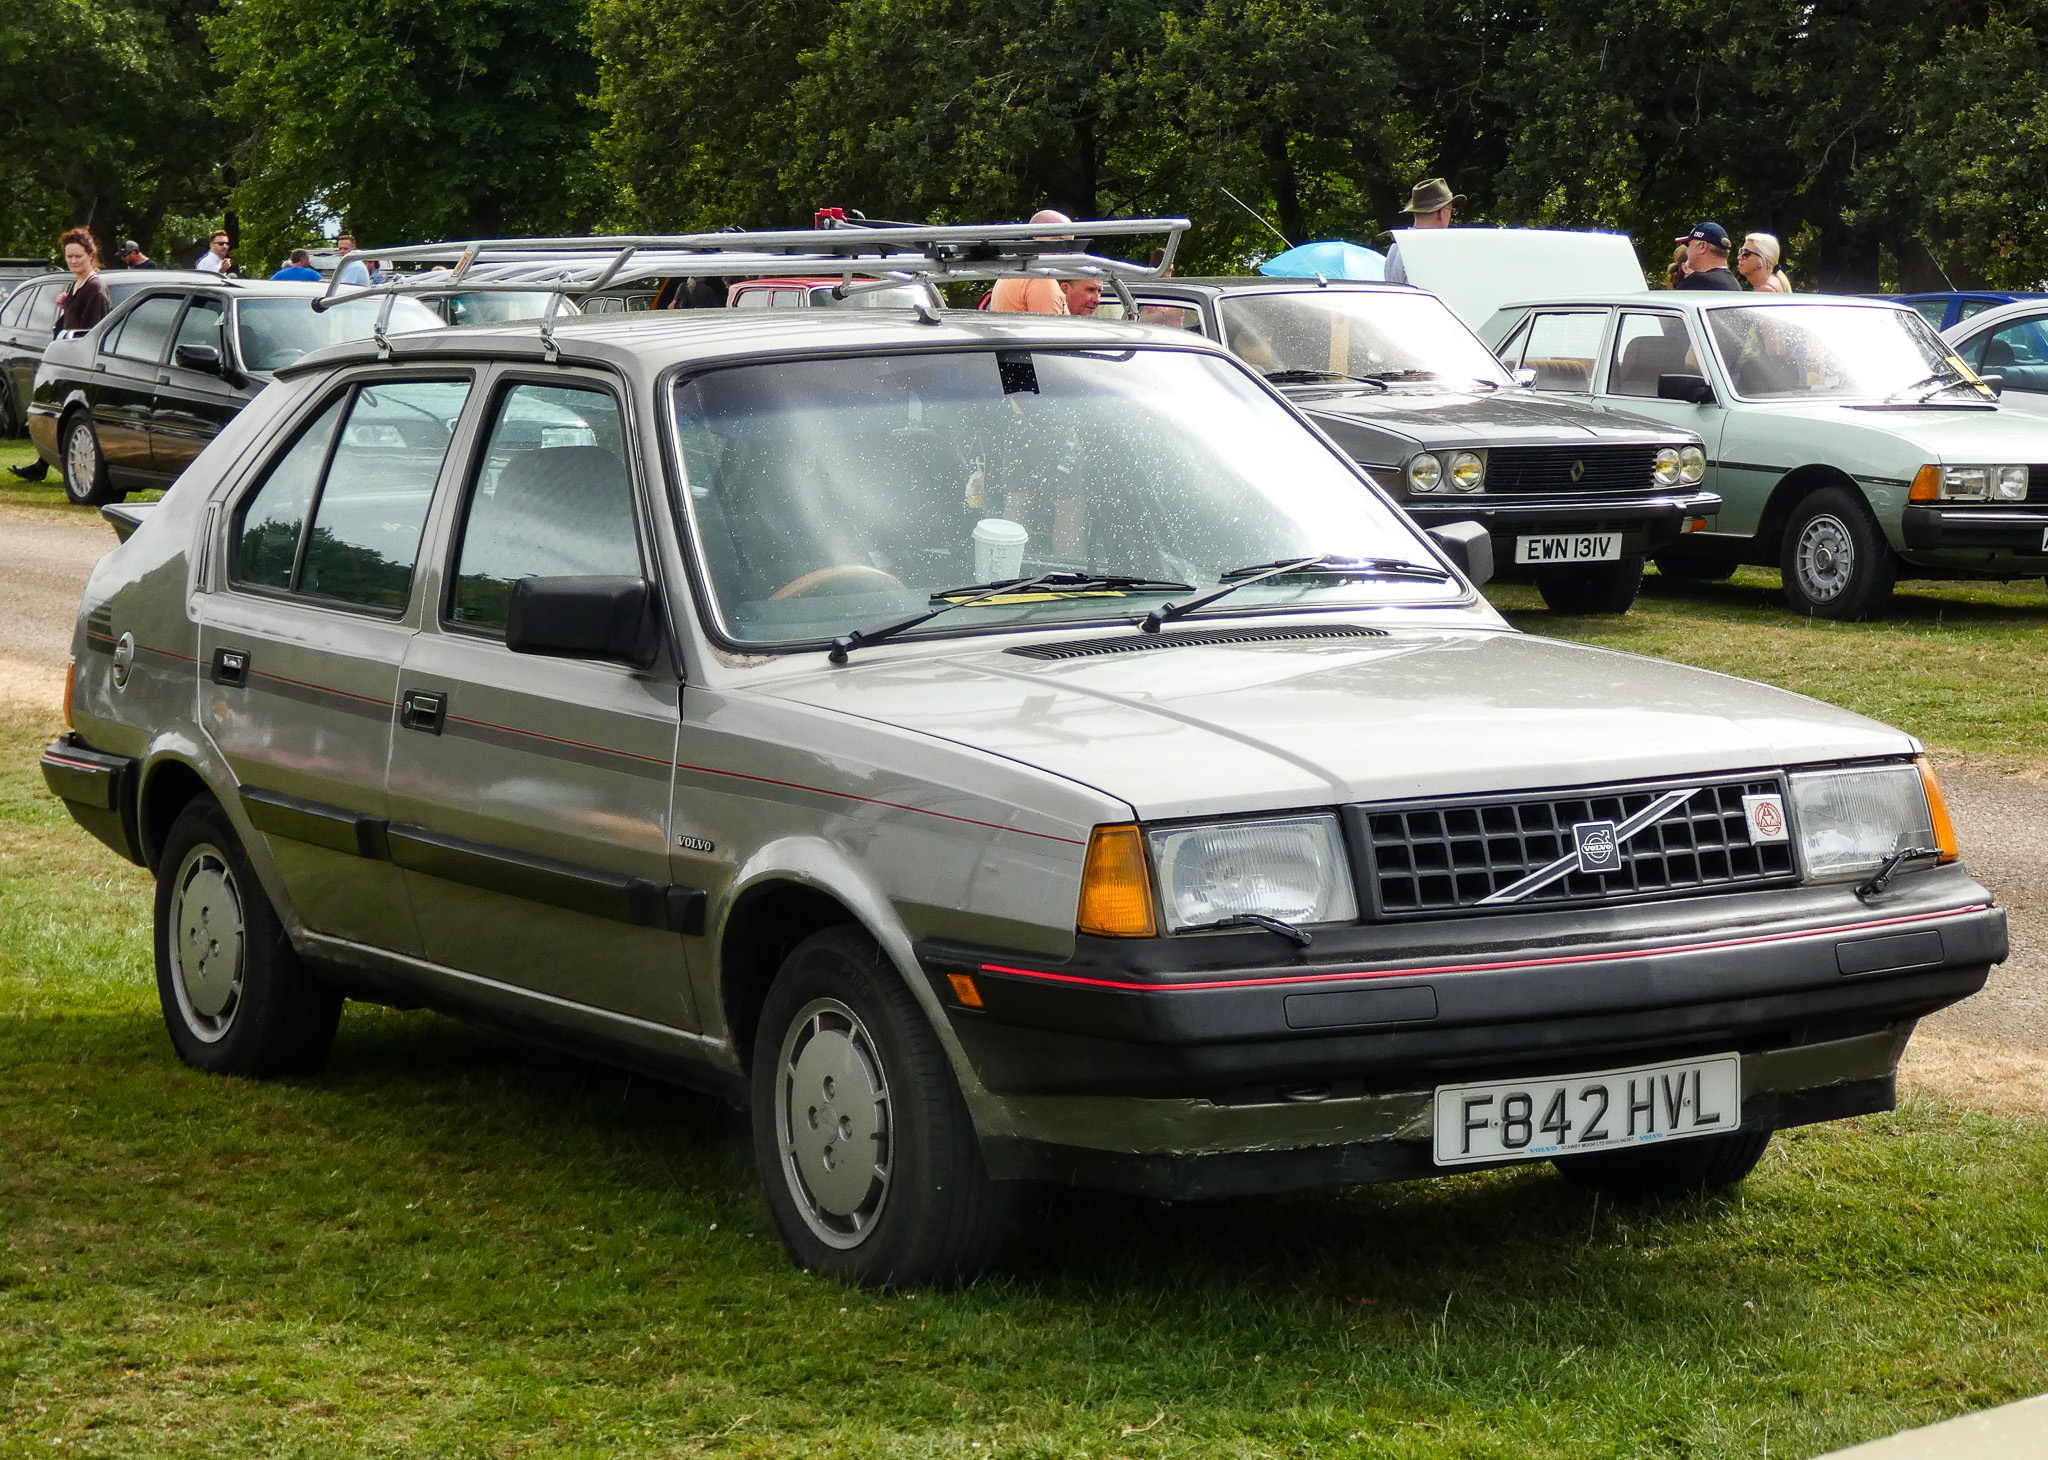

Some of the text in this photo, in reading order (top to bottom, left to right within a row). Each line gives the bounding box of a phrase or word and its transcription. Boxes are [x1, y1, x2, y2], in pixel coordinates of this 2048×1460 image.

[1528, 537, 1611, 560] EWN 131V
[678, 835, 711, 851] VOLVO
[1460, 1069, 1720, 1154] F842 HVL
